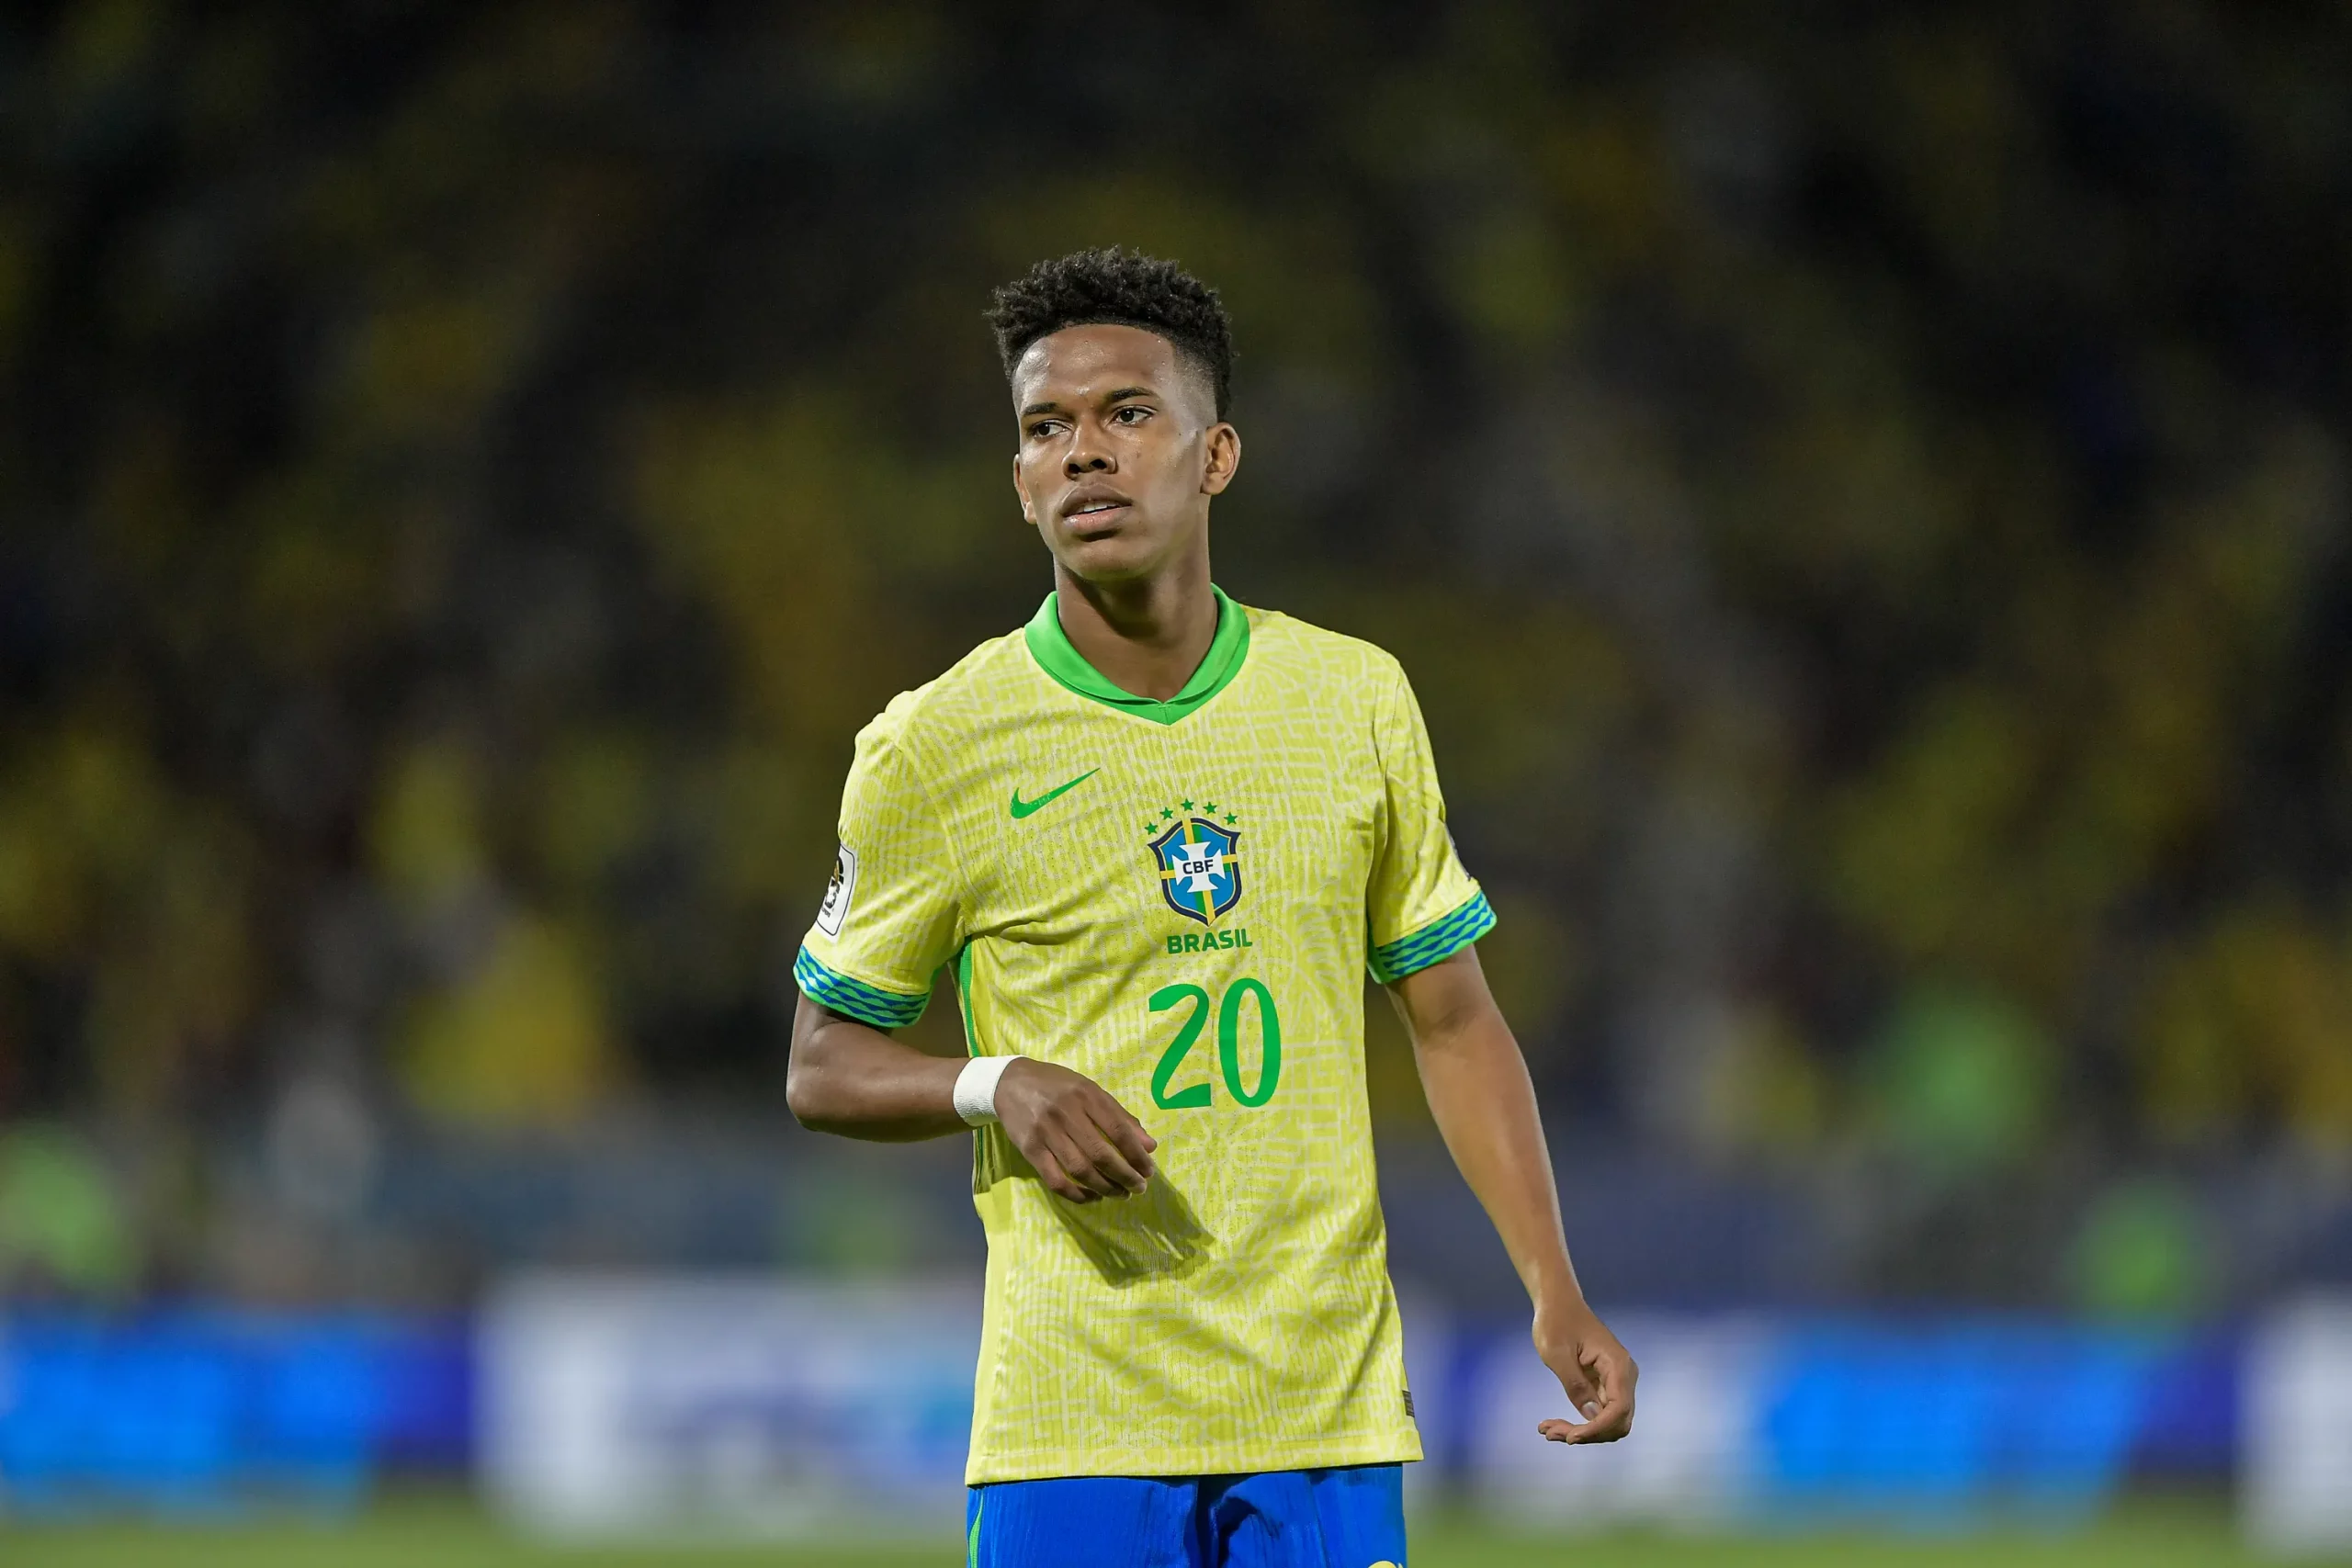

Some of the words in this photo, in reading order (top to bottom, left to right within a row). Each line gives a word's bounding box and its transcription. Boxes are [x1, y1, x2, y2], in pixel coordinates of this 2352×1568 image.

[1182, 859, 1214, 874] CBF
[1167, 929, 1252, 954] BRASIL
[1148, 977, 1282, 1110] 20
